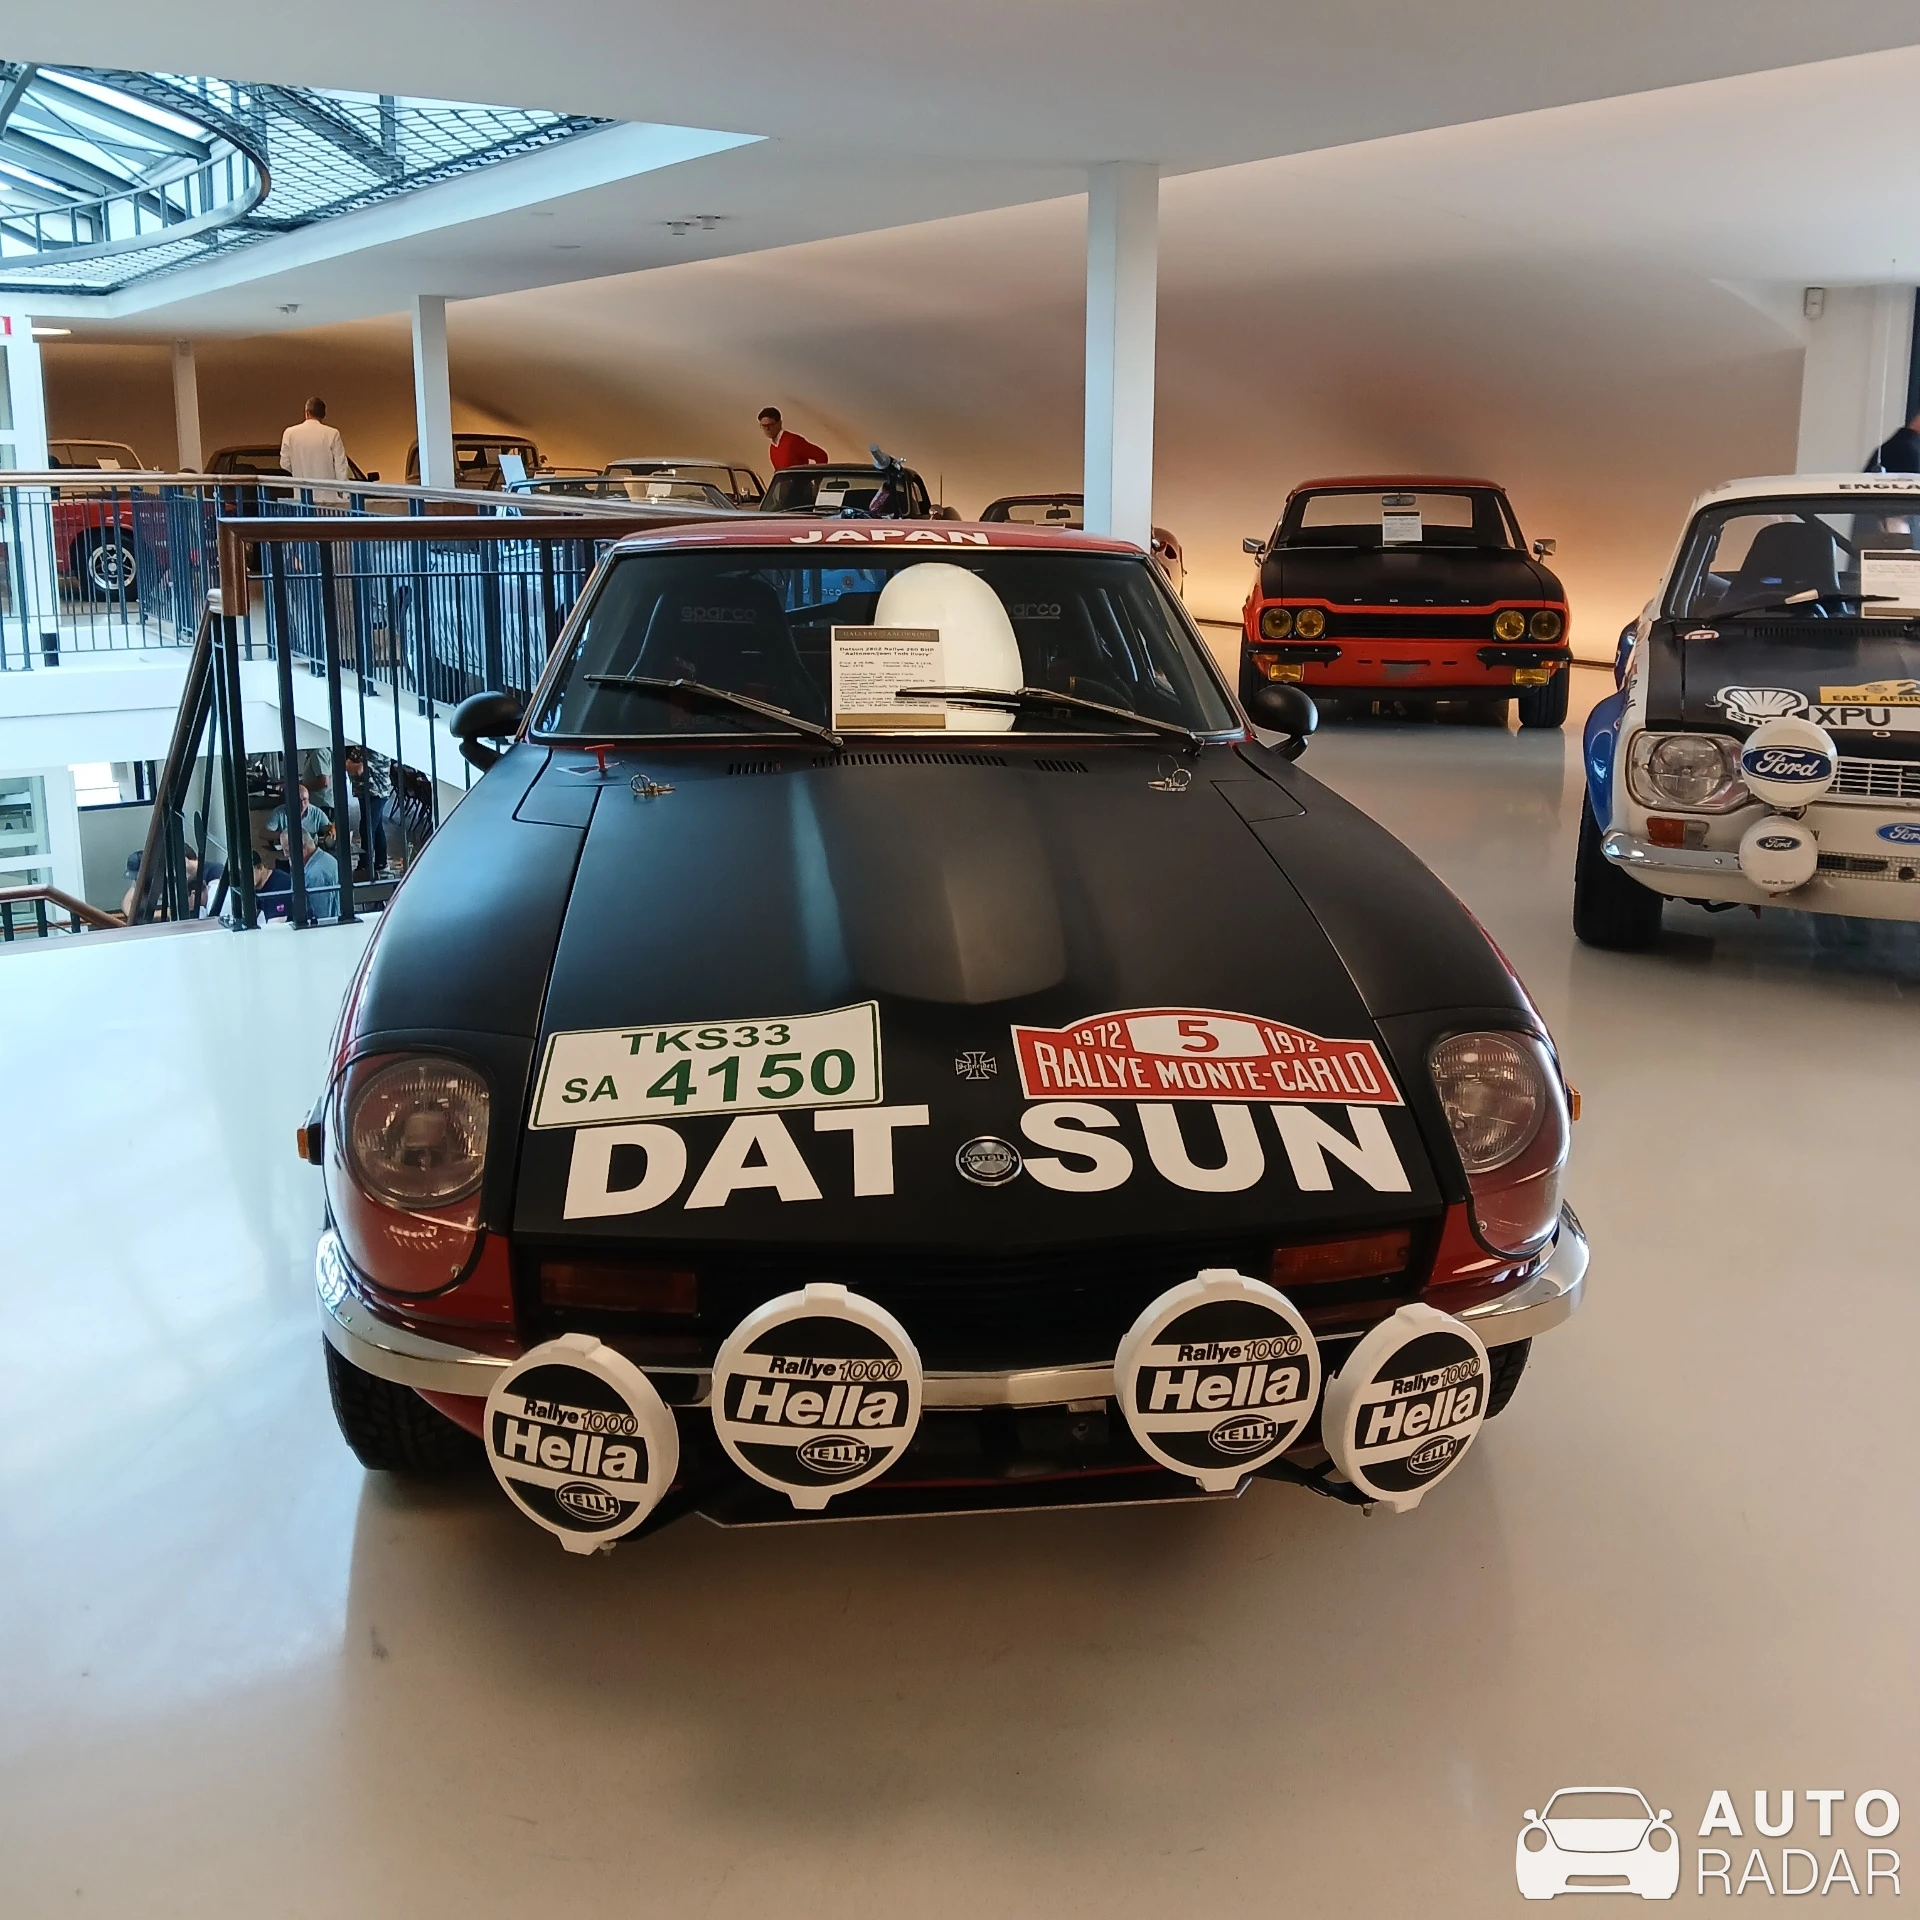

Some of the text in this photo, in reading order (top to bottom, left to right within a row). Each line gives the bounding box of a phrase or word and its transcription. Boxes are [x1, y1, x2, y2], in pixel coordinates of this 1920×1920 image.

[789, 529, 989, 545] JAPAN
[1006, 603, 1061, 617] arco
[1814, 706, 1891, 727] XPU
[1755, 750, 1821, 777] Ford
[1765, 837, 1793, 848] Ford
[1889, 825, 1920, 841] For
[621, 1023, 791, 1055] TKS33
[1073, 1021, 1126, 1050] 1972
[1177, 1019, 1220, 1053] 5
[1262, 1026, 1320, 1054] 1972
[561, 1048, 856, 1106] SA 4150
[1033, 1040, 1382, 1095] RALLYE MONTE-CARLO
[563, 1101, 1412, 1220] DAT SUN
[1177, 1335, 1303, 1364] Rallye 1000
[769, 1356, 903, 1381] Rallye 1000
[1390, 1356, 1481, 1397] Rallye 1000
[1148, 1364, 1301, 1411] Hella
[523, 1396, 639, 1437] Rallye 1000
[735, 1380, 901, 1429] Hella
[1363, 1383, 1479, 1446] Hella
[1214, 1419, 1278, 1442] HELLA
[503, 1418, 638, 1480] Hella
[802, 1443, 871, 1464] HELLA
[1411, 1438, 1457, 1465] HELLA
[558, 1491, 619, 1515] HELLA
